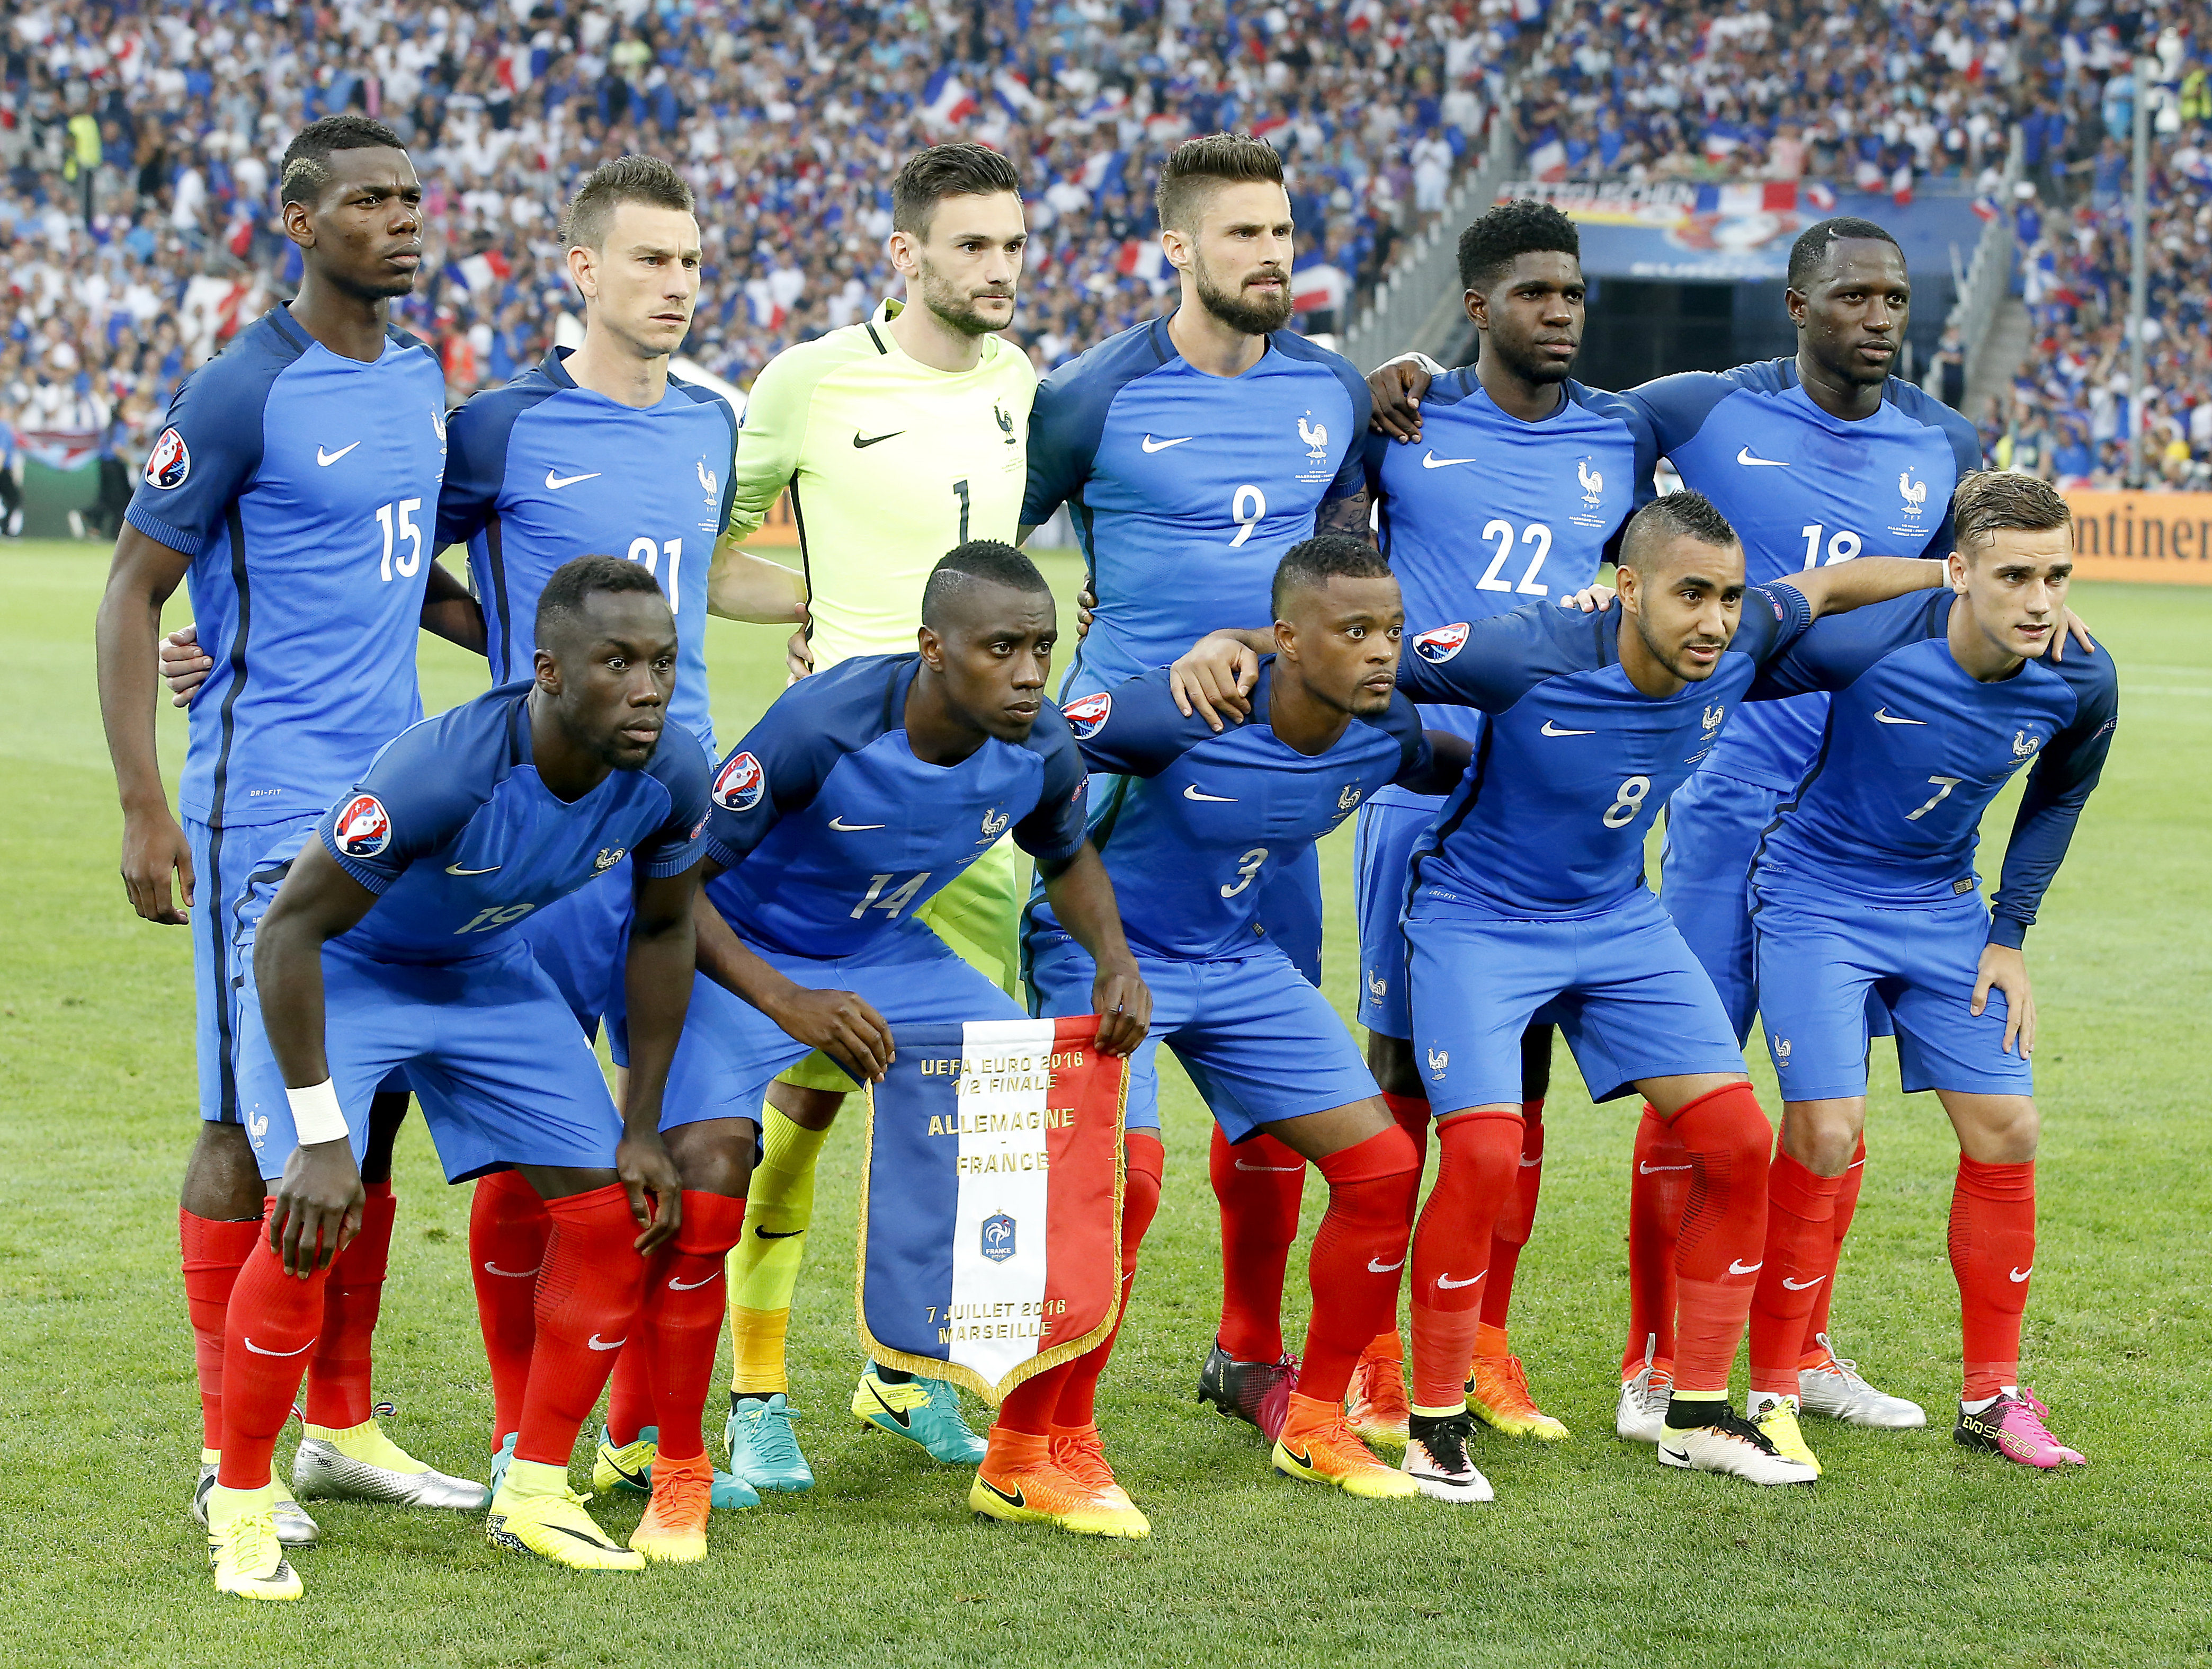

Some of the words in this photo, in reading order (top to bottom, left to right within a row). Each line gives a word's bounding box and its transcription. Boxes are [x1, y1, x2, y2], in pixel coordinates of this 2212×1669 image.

[953, 480, 969, 543] 1
[1228, 484, 1266, 547] 9
[376, 498, 422, 582] 15
[1475, 519, 1552, 596] 22
[1602, 776, 1651, 829] 8
[1905, 775, 1963, 821] 7
[849, 872, 931, 919] 14
[1220, 848, 1269, 898] 3
[454, 903, 535, 935] 19
[921, 1059, 973, 1076] UEFA
[982, 1057, 1032, 1073] EURO
[1040, 1051, 1084, 1070] 2016
[951, 1079, 980, 1096] 1/2
[990, 1074, 1058, 1093] FINALE
[927, 1108, 1075, 1136] ALLEMAGNE
[956, 1151, 1050, 1176] FRANCE
[926, 1306, 937, 1324] 7
[943, 1303, 1015, 1320] JUILLET
[1021, 1299, 1066, 1316] 2016
[938, 1321, 1053, 1344] MARSEILLE
